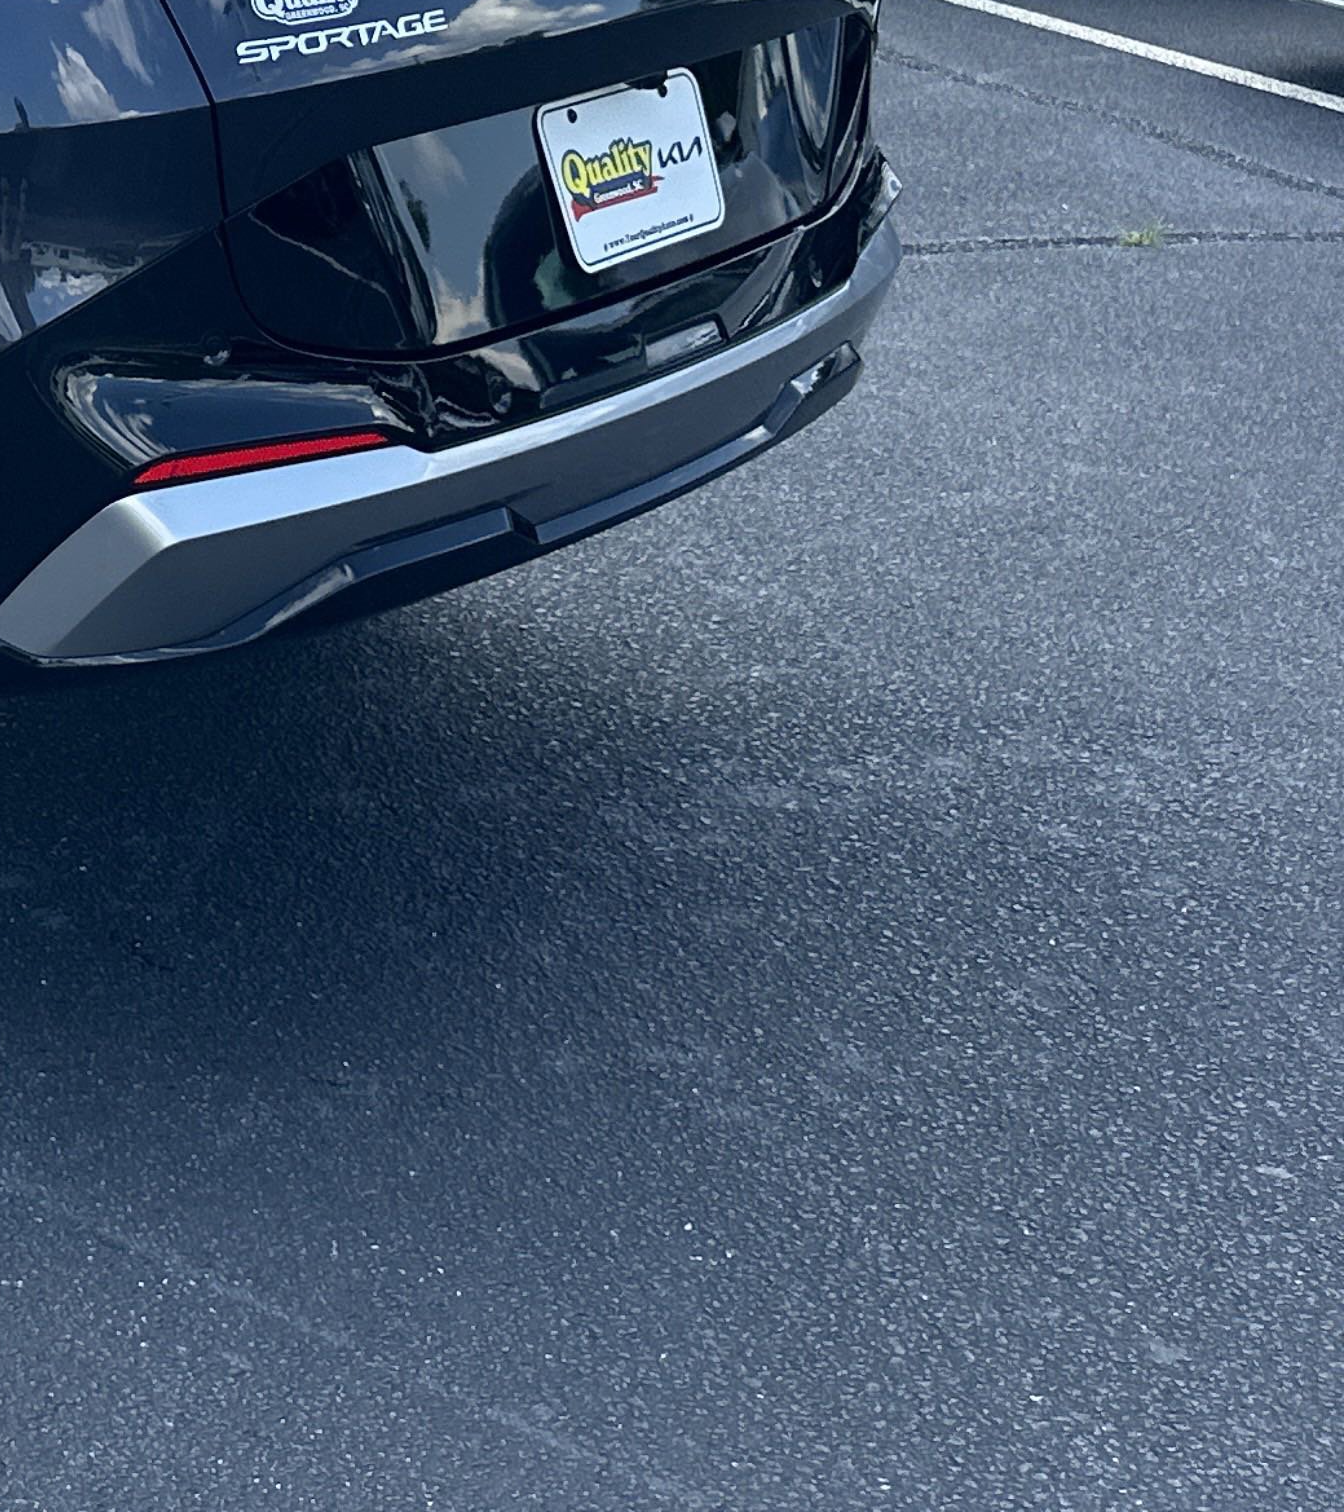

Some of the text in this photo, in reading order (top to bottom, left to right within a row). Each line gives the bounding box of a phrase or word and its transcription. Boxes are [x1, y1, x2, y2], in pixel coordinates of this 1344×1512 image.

[236, 8, 449, 64] SPORTAGE
[563, 136, 703, 199] Quality KIA
